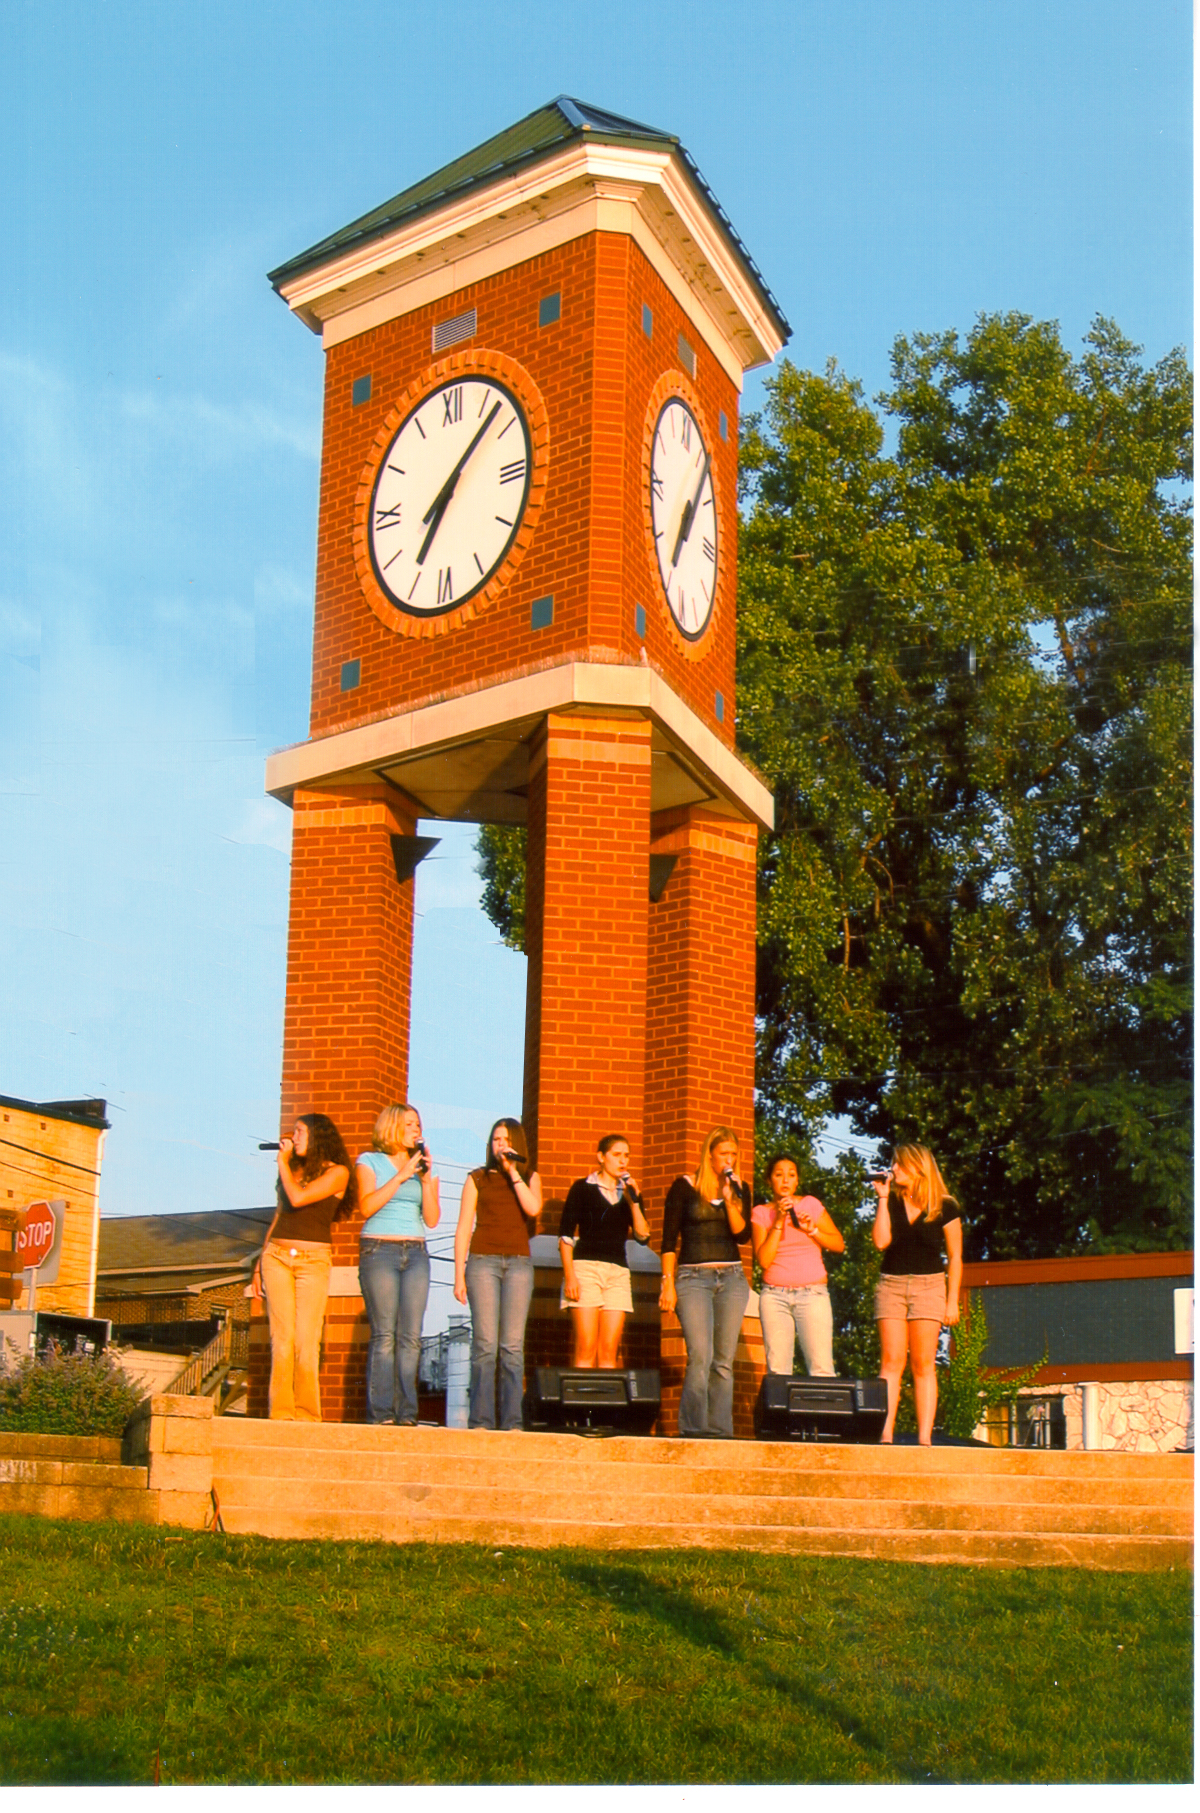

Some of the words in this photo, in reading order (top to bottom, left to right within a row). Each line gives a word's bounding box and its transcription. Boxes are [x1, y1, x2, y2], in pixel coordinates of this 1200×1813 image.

[443, 386, 463, 427] XII
[500, 459, 526, 485] III
[375, 503, 402, 531] IX
[703, 537, 715, 563] III
[437, 566, 453, 605] VI
[19, 1221, 52, 1249] STOP
